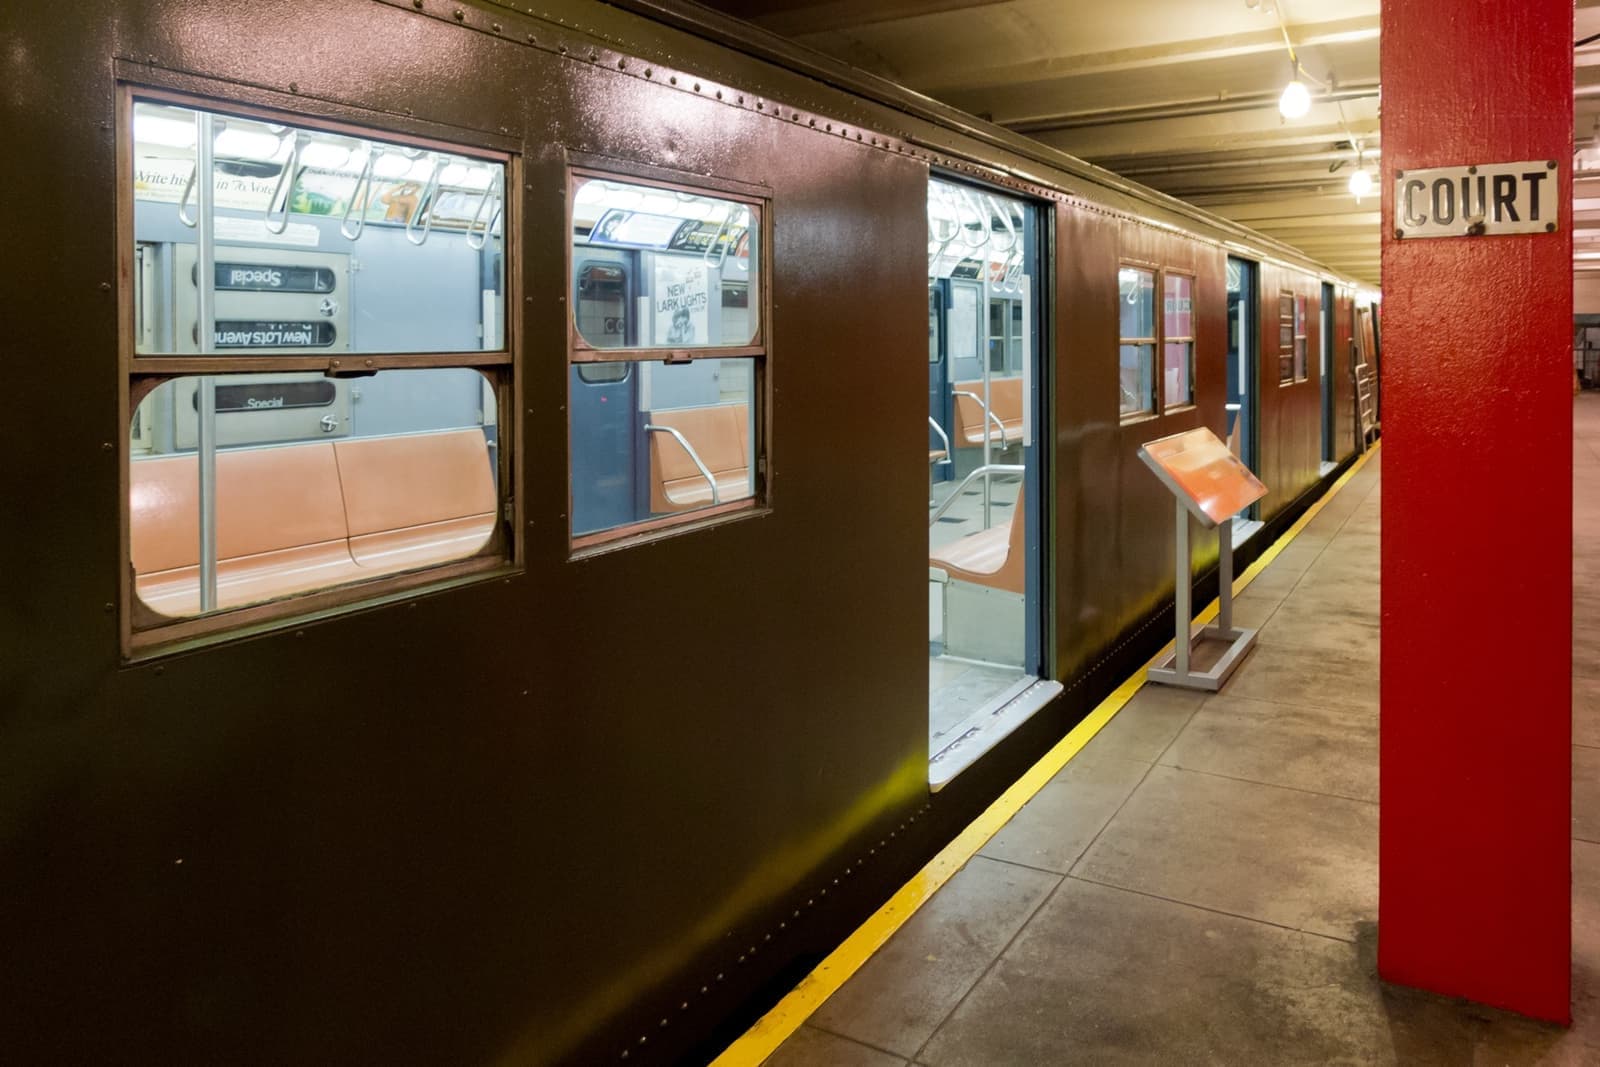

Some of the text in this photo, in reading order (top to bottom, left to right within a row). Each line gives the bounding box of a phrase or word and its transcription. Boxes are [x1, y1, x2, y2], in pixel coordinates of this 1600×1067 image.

[1404, 172, 1548, 226] COURT
[231, 269, 282, 287] Special
[667, 283, 686, 298] NEW
[656, 297, 679, 313] LARK
[680, 292, 708, 308] LIGHTS
[605, 319, 625, 332] CO
[253, 331, 282, 345] Lots
[283, 331, 312, 345] New
[248, 397, 283, 409] Special
